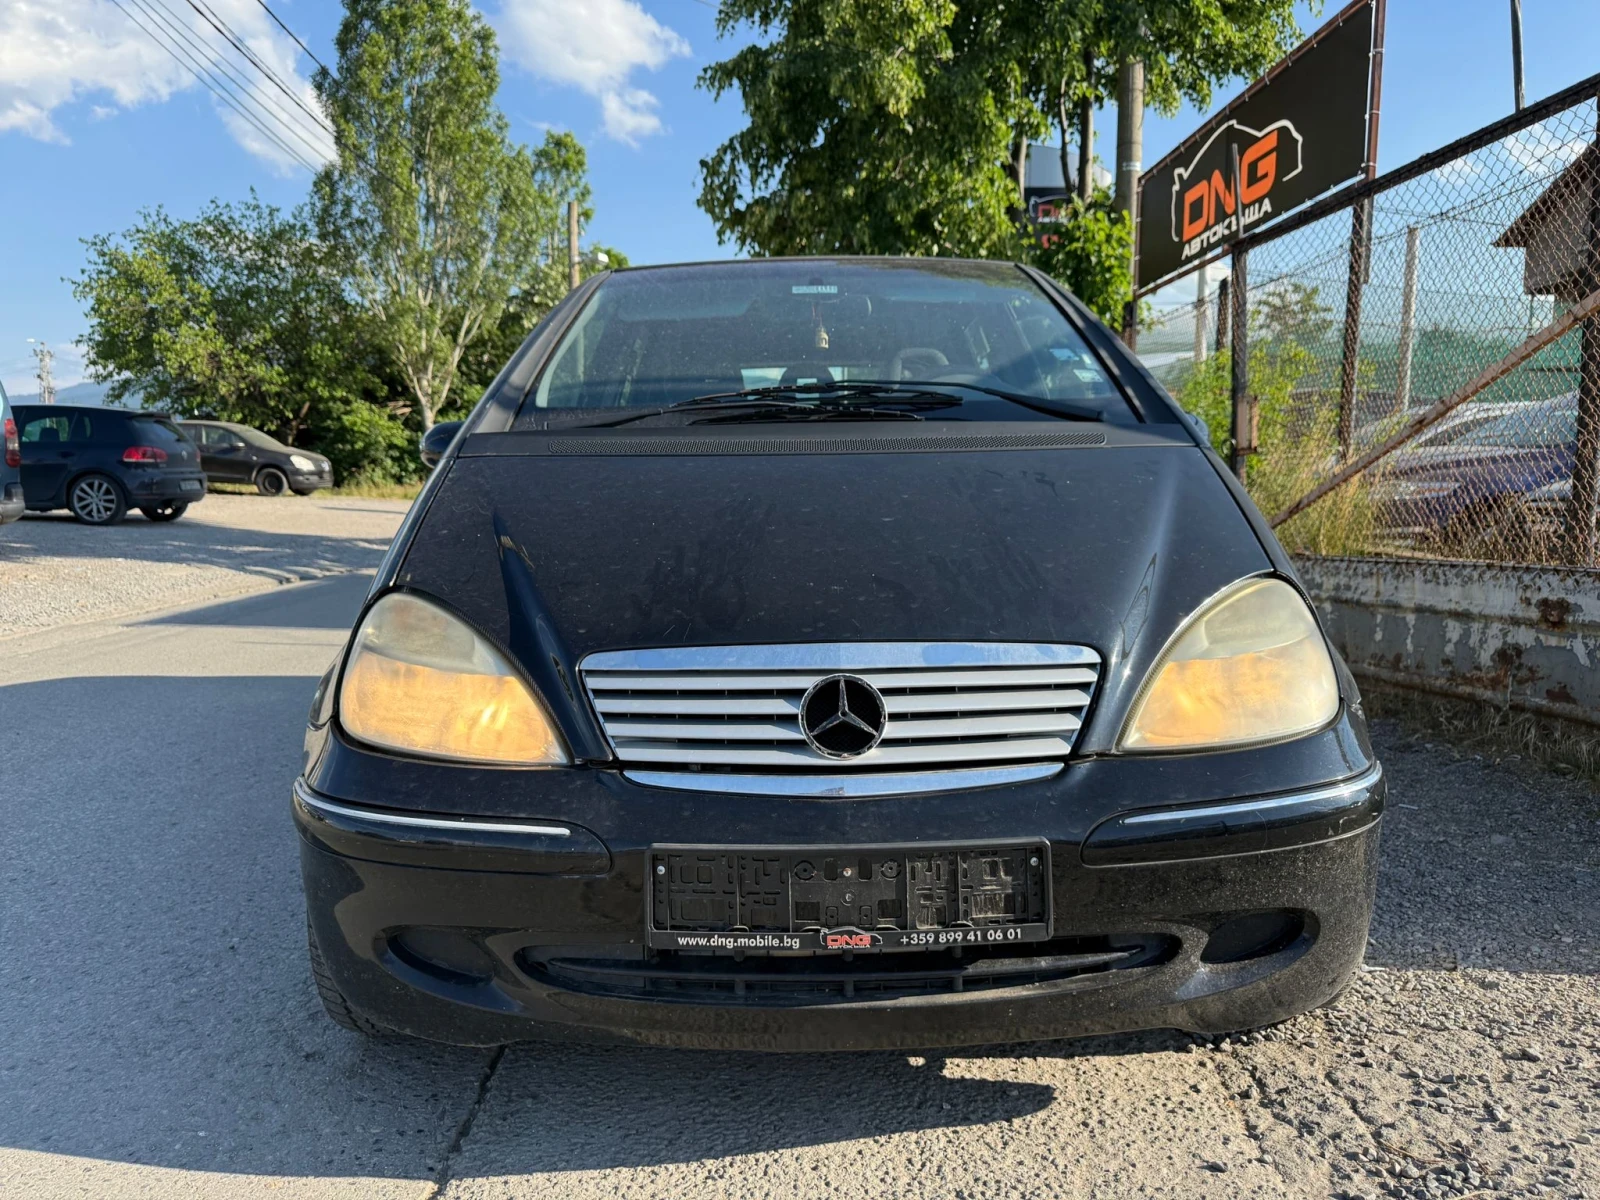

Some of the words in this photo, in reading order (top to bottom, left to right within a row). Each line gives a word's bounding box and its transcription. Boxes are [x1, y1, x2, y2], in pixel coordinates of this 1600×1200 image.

[1183, 130, 1278, 242] DNG
[678, 934, 800, 949] www.dng.mobile.bg
[827, 934, 871, 946] DNG
[900, 932, 935, 945] +359
[938, 931, 963, 943] 899
[966, 930, 982, 942] 41
[987, 929, 1003, 941] 06
[1007, 928, 1022, 940] 01
